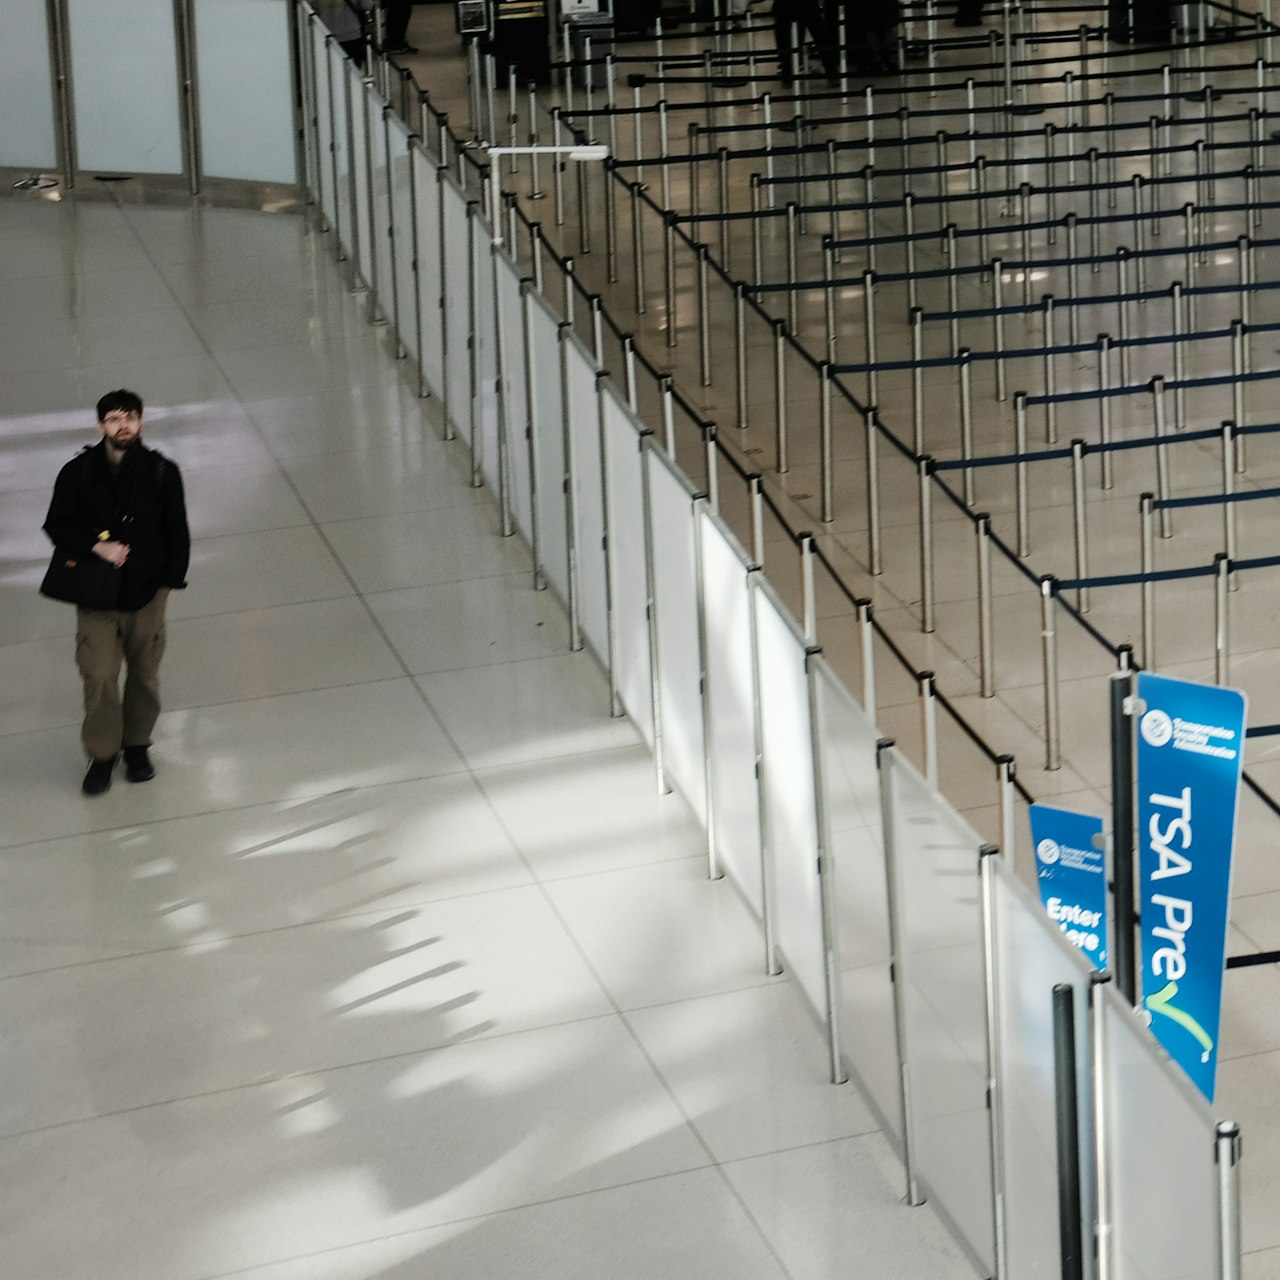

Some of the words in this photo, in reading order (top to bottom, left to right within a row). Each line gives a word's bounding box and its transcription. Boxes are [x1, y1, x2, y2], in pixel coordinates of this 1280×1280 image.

[1149, 786, 1193, 882] TSA
[1047, 896, 1102, 929] Enter
[1151, 893, 1193, 982] Pre
